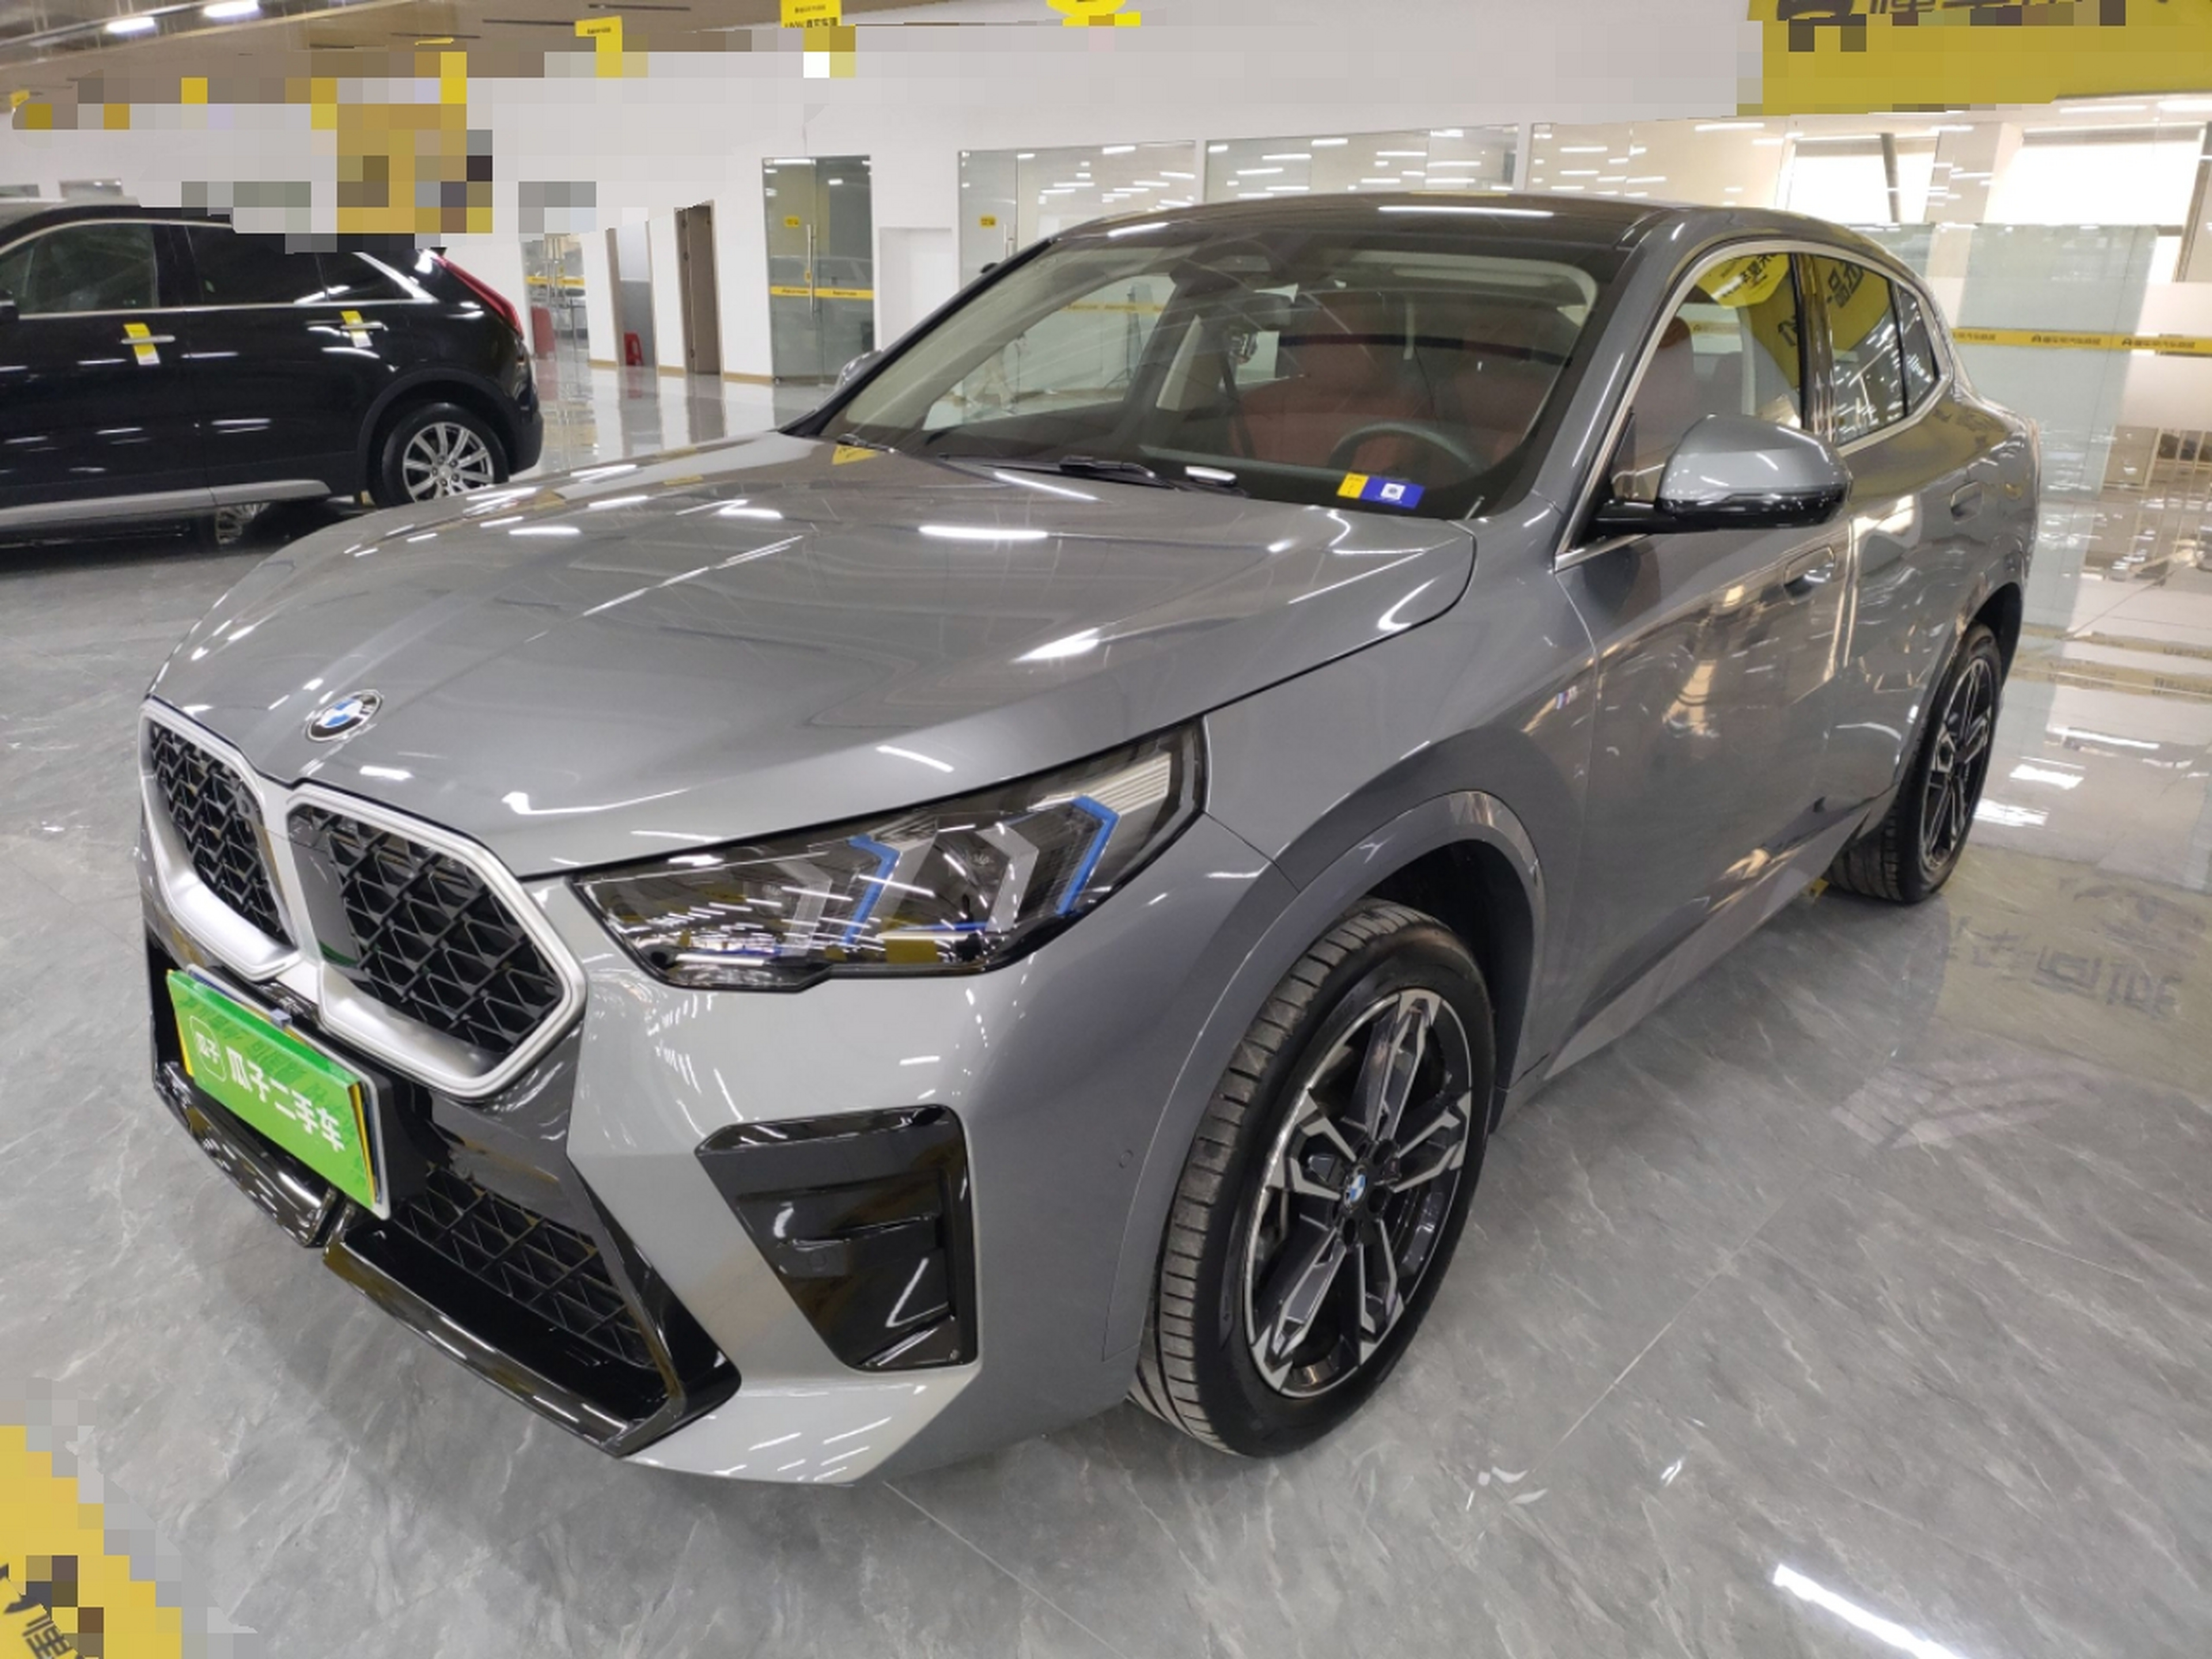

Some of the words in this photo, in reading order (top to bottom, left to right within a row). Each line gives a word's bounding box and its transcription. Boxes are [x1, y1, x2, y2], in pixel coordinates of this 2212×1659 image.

[226, 1046, 345, 1152] 瓜子二手车
